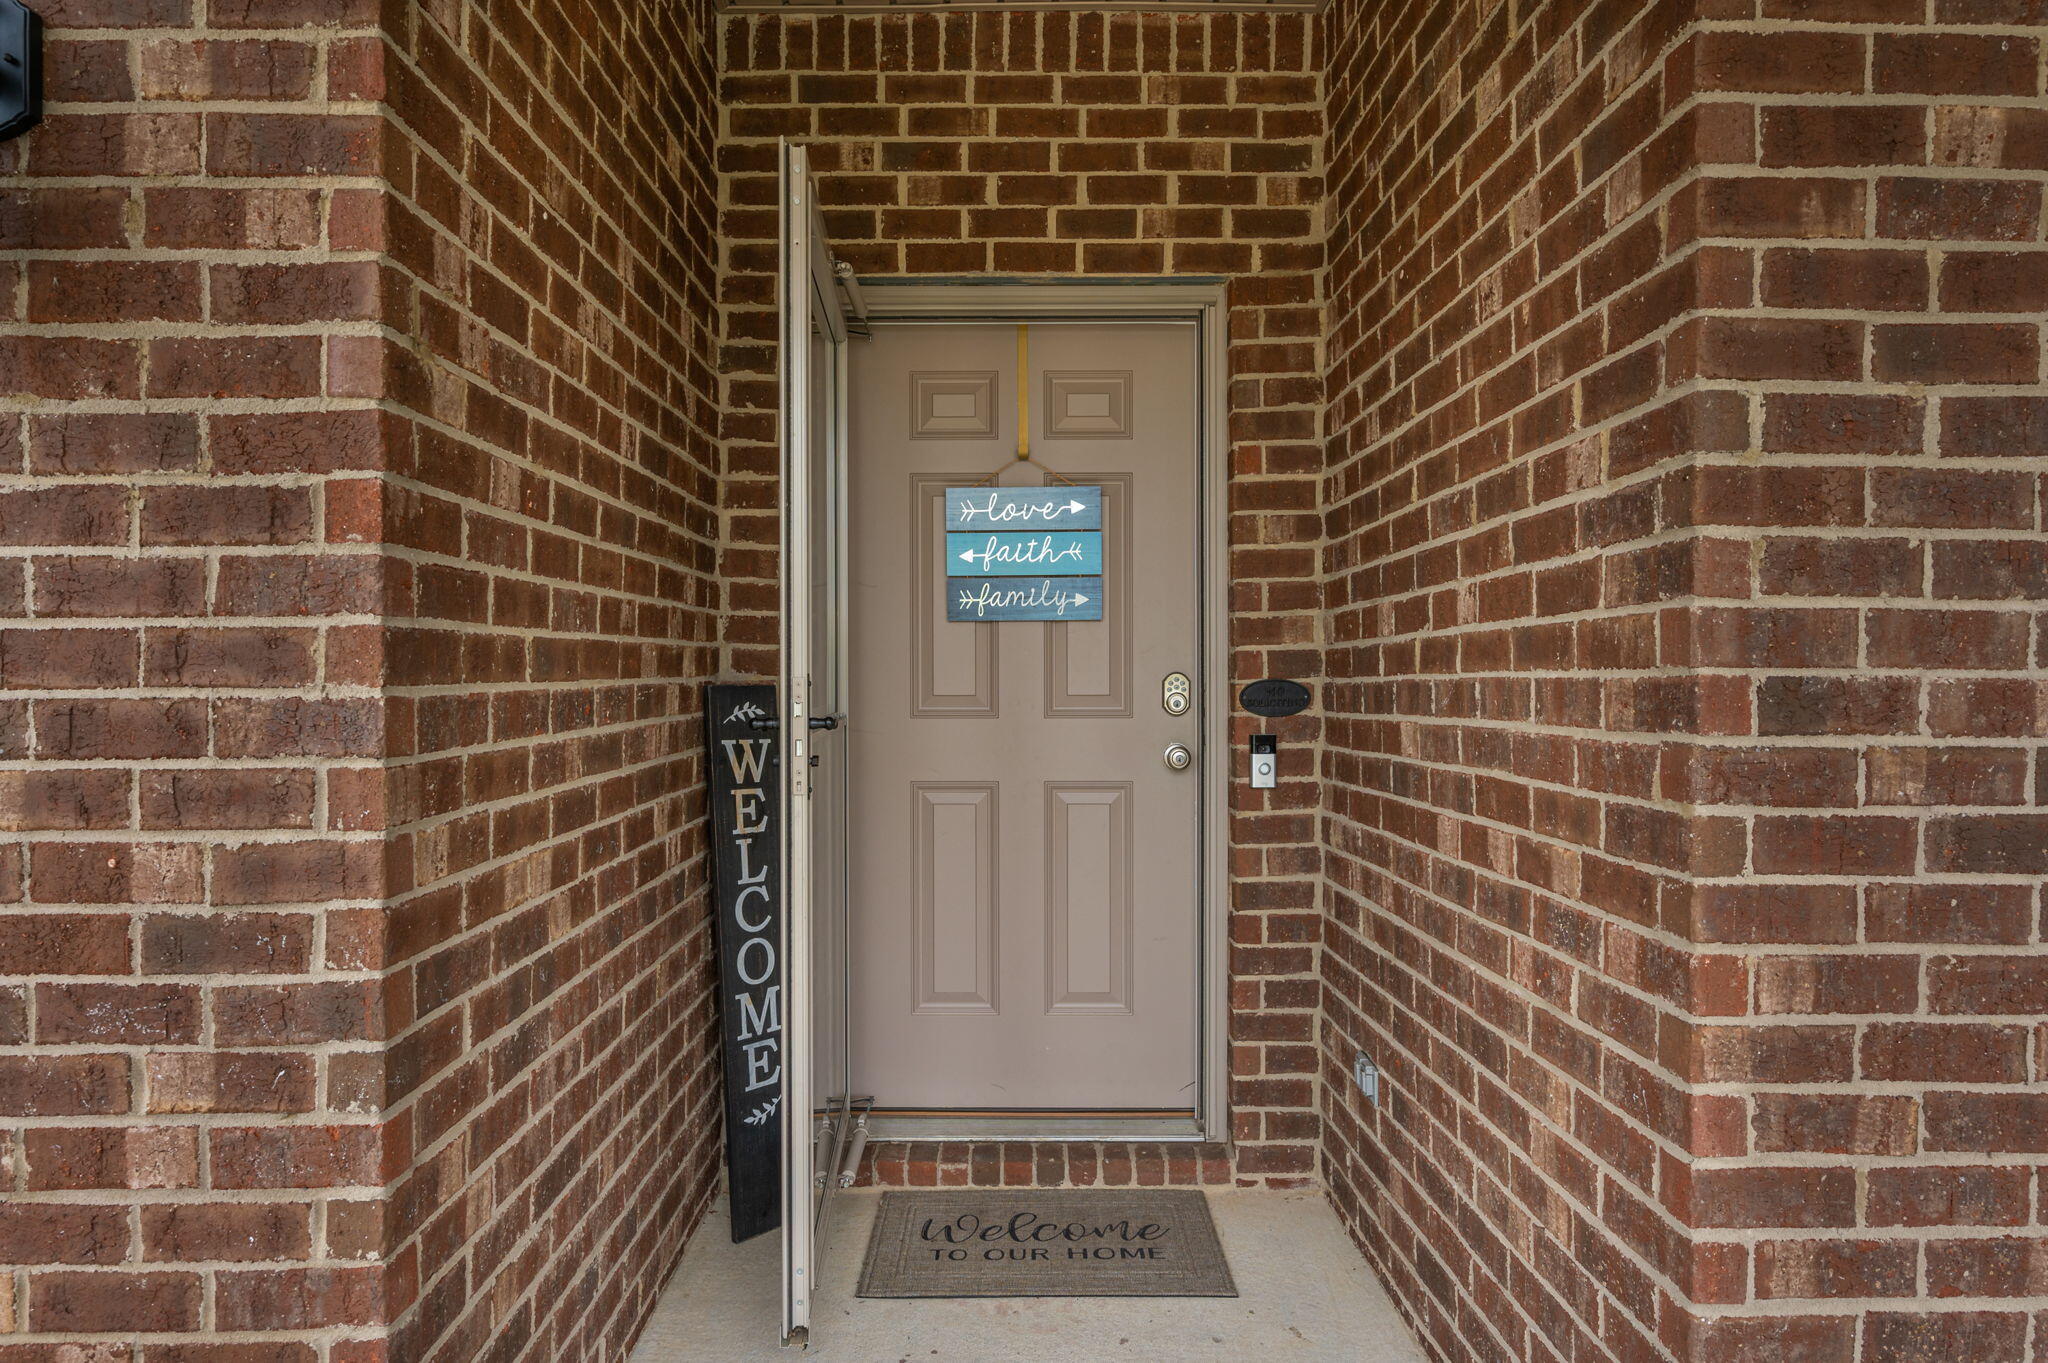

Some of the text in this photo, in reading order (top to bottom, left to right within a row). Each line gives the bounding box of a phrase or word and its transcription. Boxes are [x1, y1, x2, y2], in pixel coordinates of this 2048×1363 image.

[986, 493, 1061, 521] love
[983, 536, 1059, 571] faith
[977, 580, 1070, 616] family
[721, 738, 782, 1092] WELCOME
[921, 1212, 1170, 1243] Welcome
[930, 1247, 1167, 1261] TO OUR HOME
